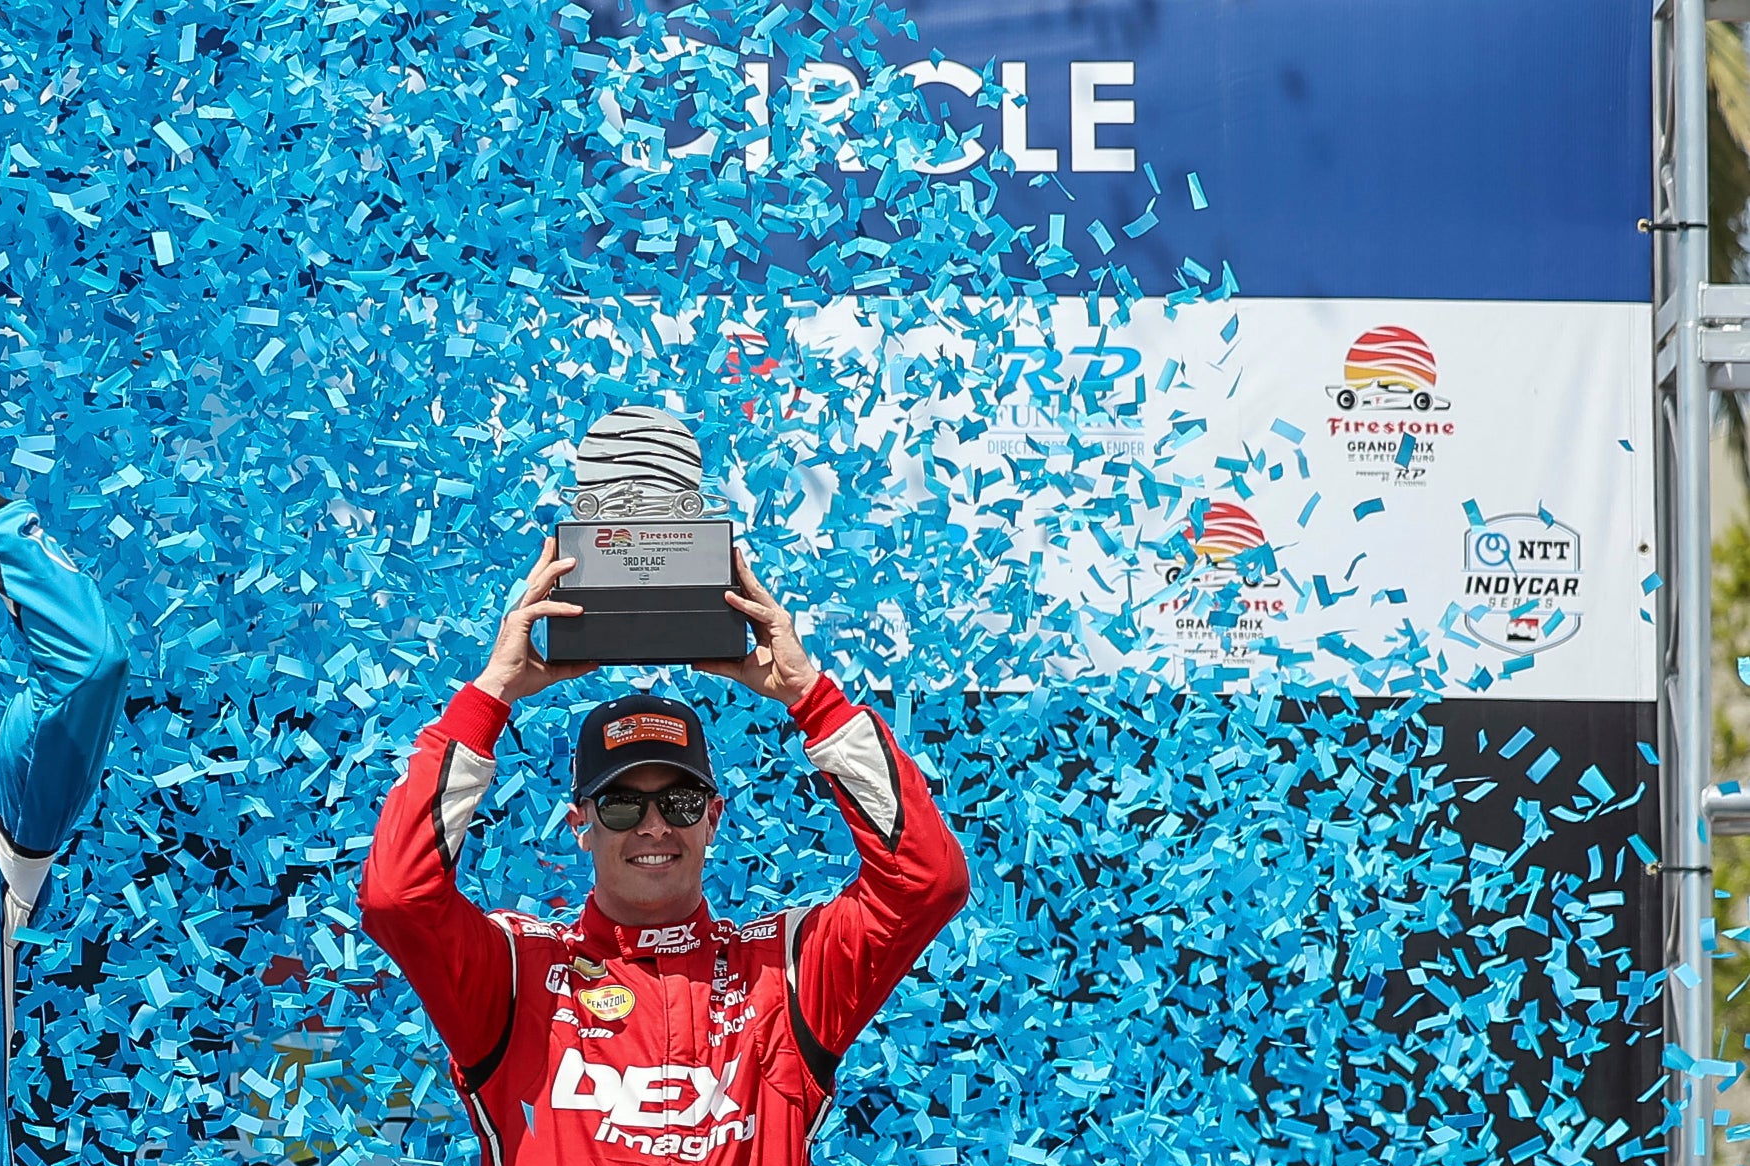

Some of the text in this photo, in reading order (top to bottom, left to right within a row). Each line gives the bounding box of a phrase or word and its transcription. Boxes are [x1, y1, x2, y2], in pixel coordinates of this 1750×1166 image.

[1327, 417, 1455, 436] Firestone
[1105, 440, 1145, 456] ENDER
[1347, 441, 1435, 453] GRAND RIX
[1395, 468, 1426, 480] RP
[638, 531, 694, 541] Firestone
[1518, 540, 1570, 560] NTT
[622, 556, 666, 567] 3RD PLACE
[1464, 576, 1580, 596] INDYCAR
[1239, 619, 1263, 630] RIX
[636, 922, 698, 948] DEX
[741, 925, 778, 940] OMP
[551, 1047, 742, 1128] DEX
[594, 1113, 757, 1162] imaging
